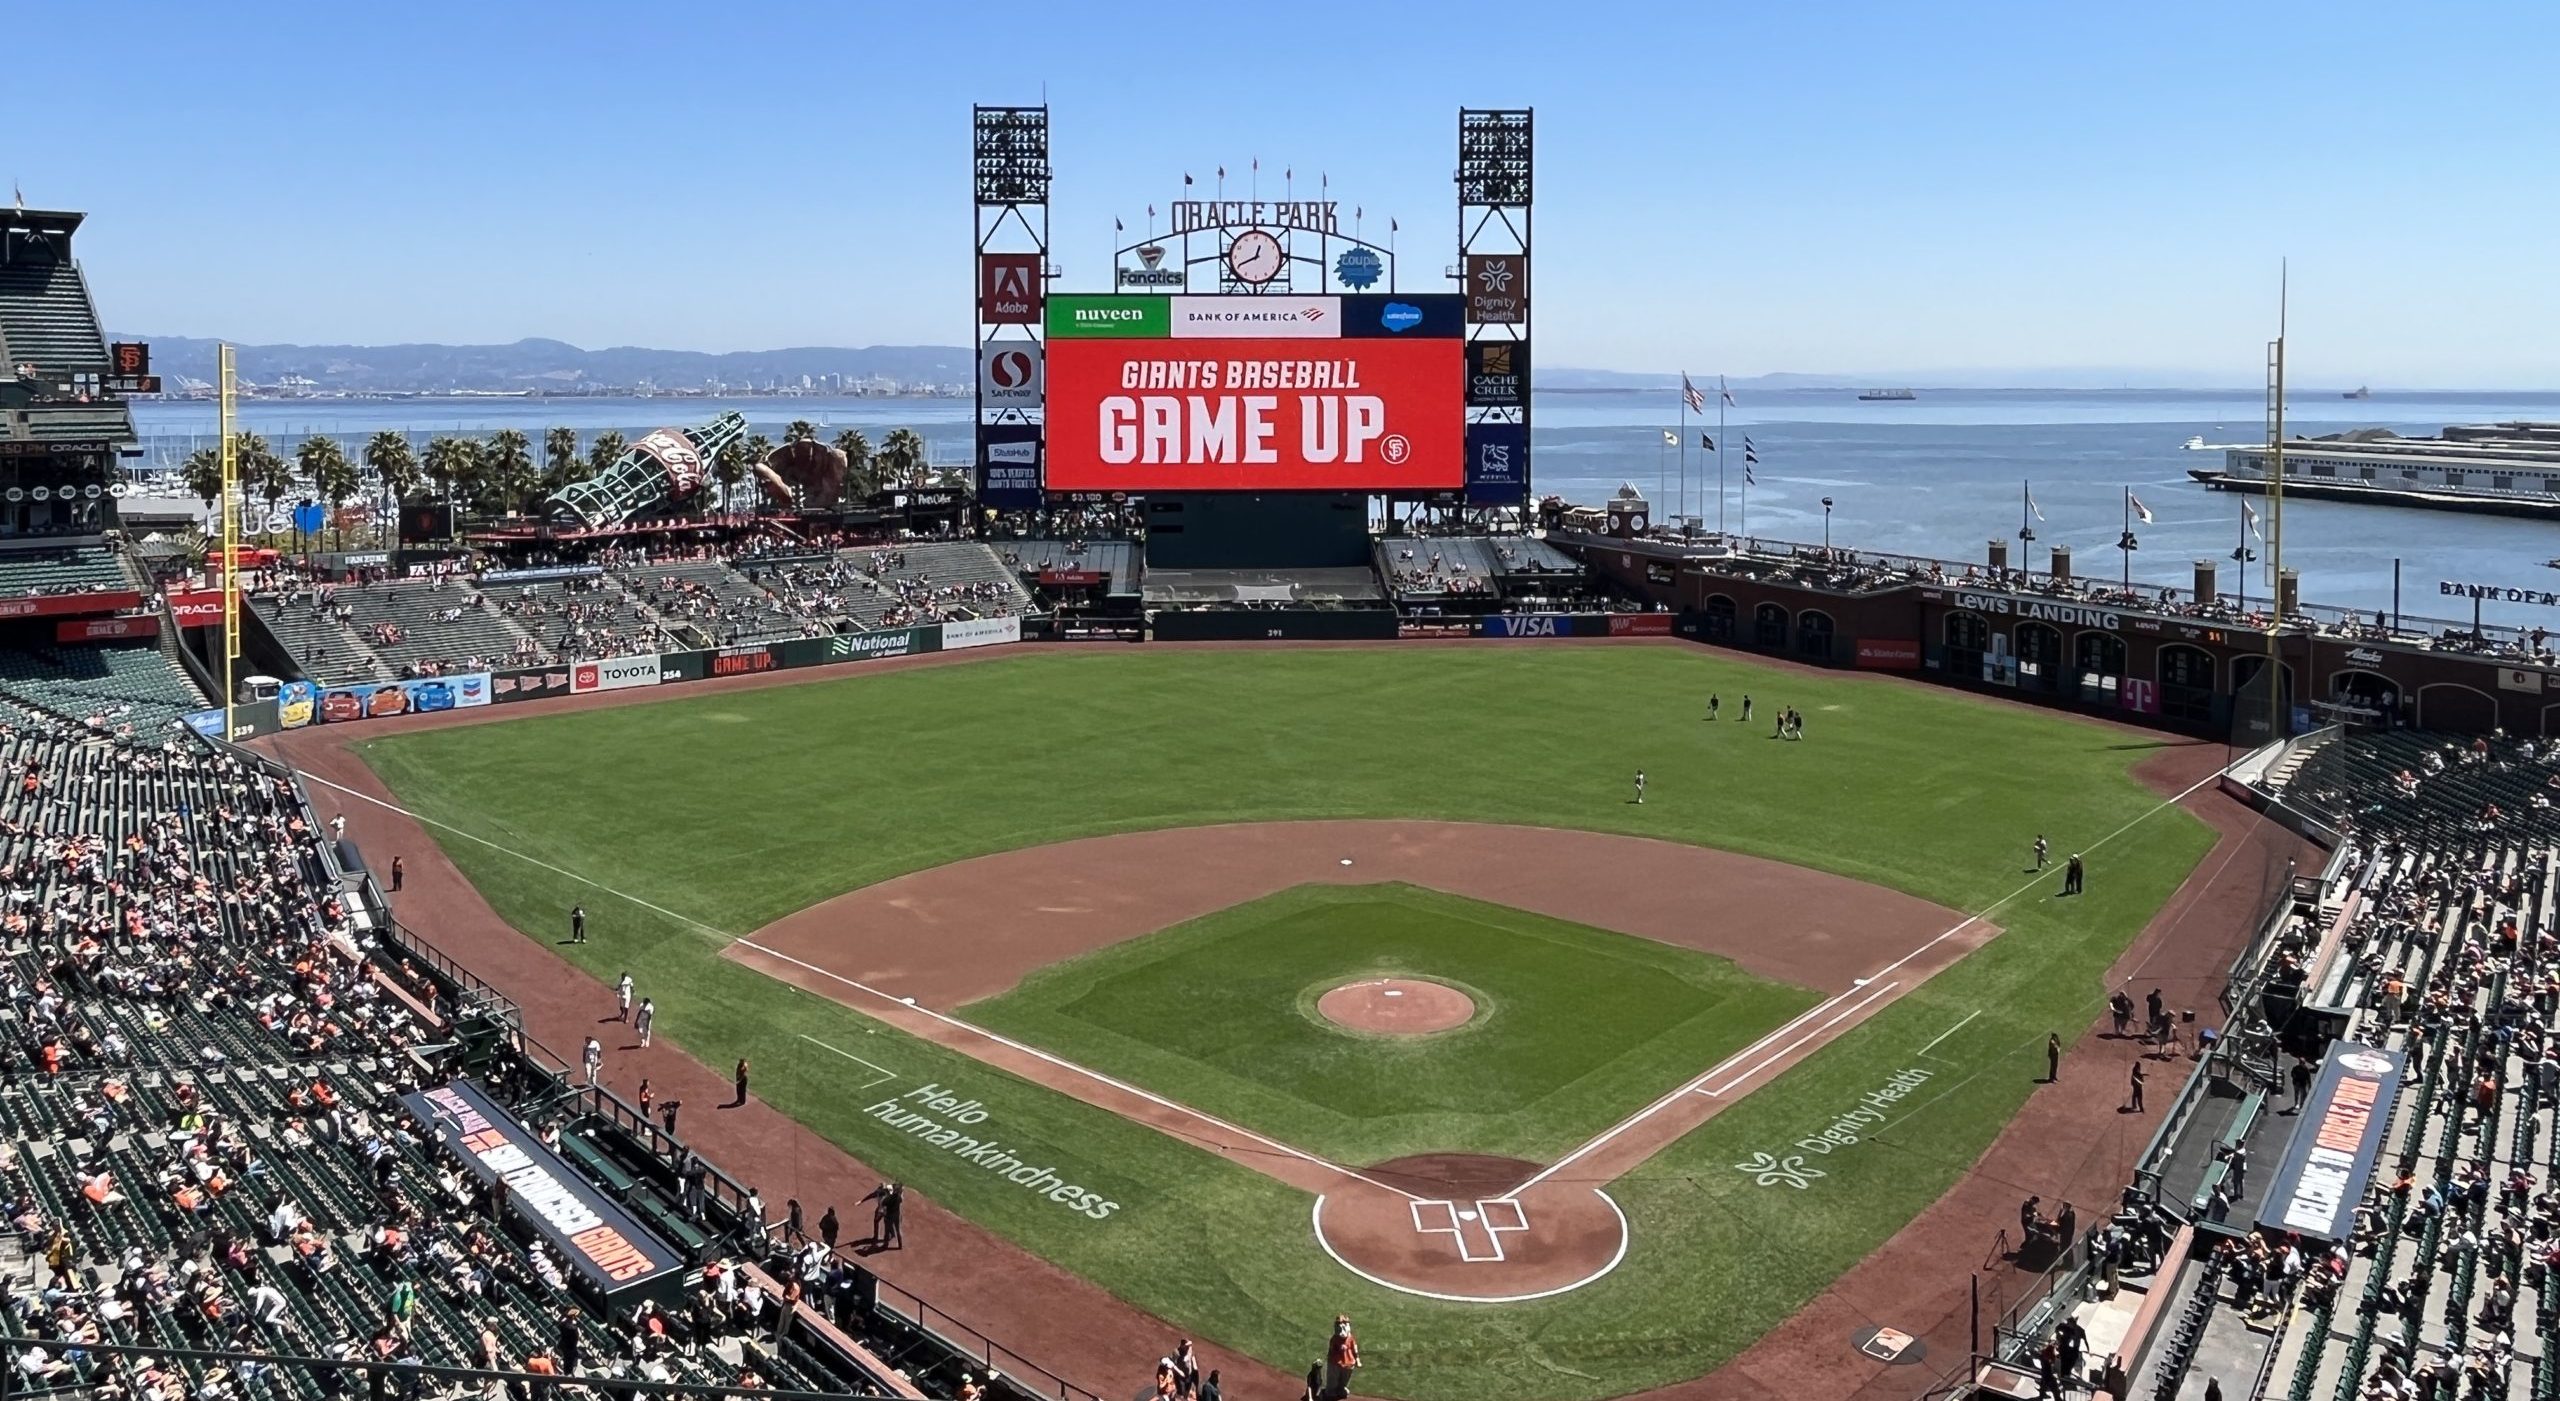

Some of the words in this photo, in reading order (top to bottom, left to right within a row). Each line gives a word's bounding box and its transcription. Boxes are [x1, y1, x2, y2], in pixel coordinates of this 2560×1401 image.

[1171, 201, 1265, 234] ORACLE
[1276, 202, 1339, 234] PARK
[1119, 268, 1184, 286] Fanatics
[995, 301, 1029, 314] Adobe
[1474, 296, 1516, 309] Dignity
[1075, 309, 1143, 321] nuveen
[1189, 313, 1222, 322] BANK
[1225, 313, 1241, 322] OF
[1243, 313, 1298, 322] AMERICA
[1476, 310, 1515, 321] Health
[1122, 361, 1219, 389] GIANTS
[1225, 361, 1361, 389] BASEBALL
[1473, 375, 1519, 386] CACHE
[991, 389, 1032, 398] SAFEWAY
[1474, 386, 1517, 396] CREEK
[1099, 395, 1278, 465] GAME
[1299, 395, 1385, 464] UP
[51, 443, 106, 452] ORACLE
[2440, 581, 2501, 601] BANK
[2507, 587, 2538, 604] OF
[172, 603, 224, 616] ORACL
[2016, 601, 2120, 631] LANDING
[1267, 628, 1283, 637] 391
[1503, 616, 1556, 636] VISA
[850, 632, 910, 651] National
[713, 655, 749, 674] GAME
[754, 652, 772, 668] UP
[603, 665, 657, 680] TOYOTA
[234, 724, 255, 737] 339
[903, 1083, 990, 1125] Hello
[1794, 1105, 1887, 1155] Dignity
[1859, 1068, 1935, 1109] Health
[2316, 1104, 2372, 1153] ORACLE
[863, 1098, 1121, 1220] humankindness
[2282, 1162, 2351, 1235] WELCOME
[503, 1163, 604, 1235] FRANCISCO
[570, 1226, 656, 1282] GIANTS
